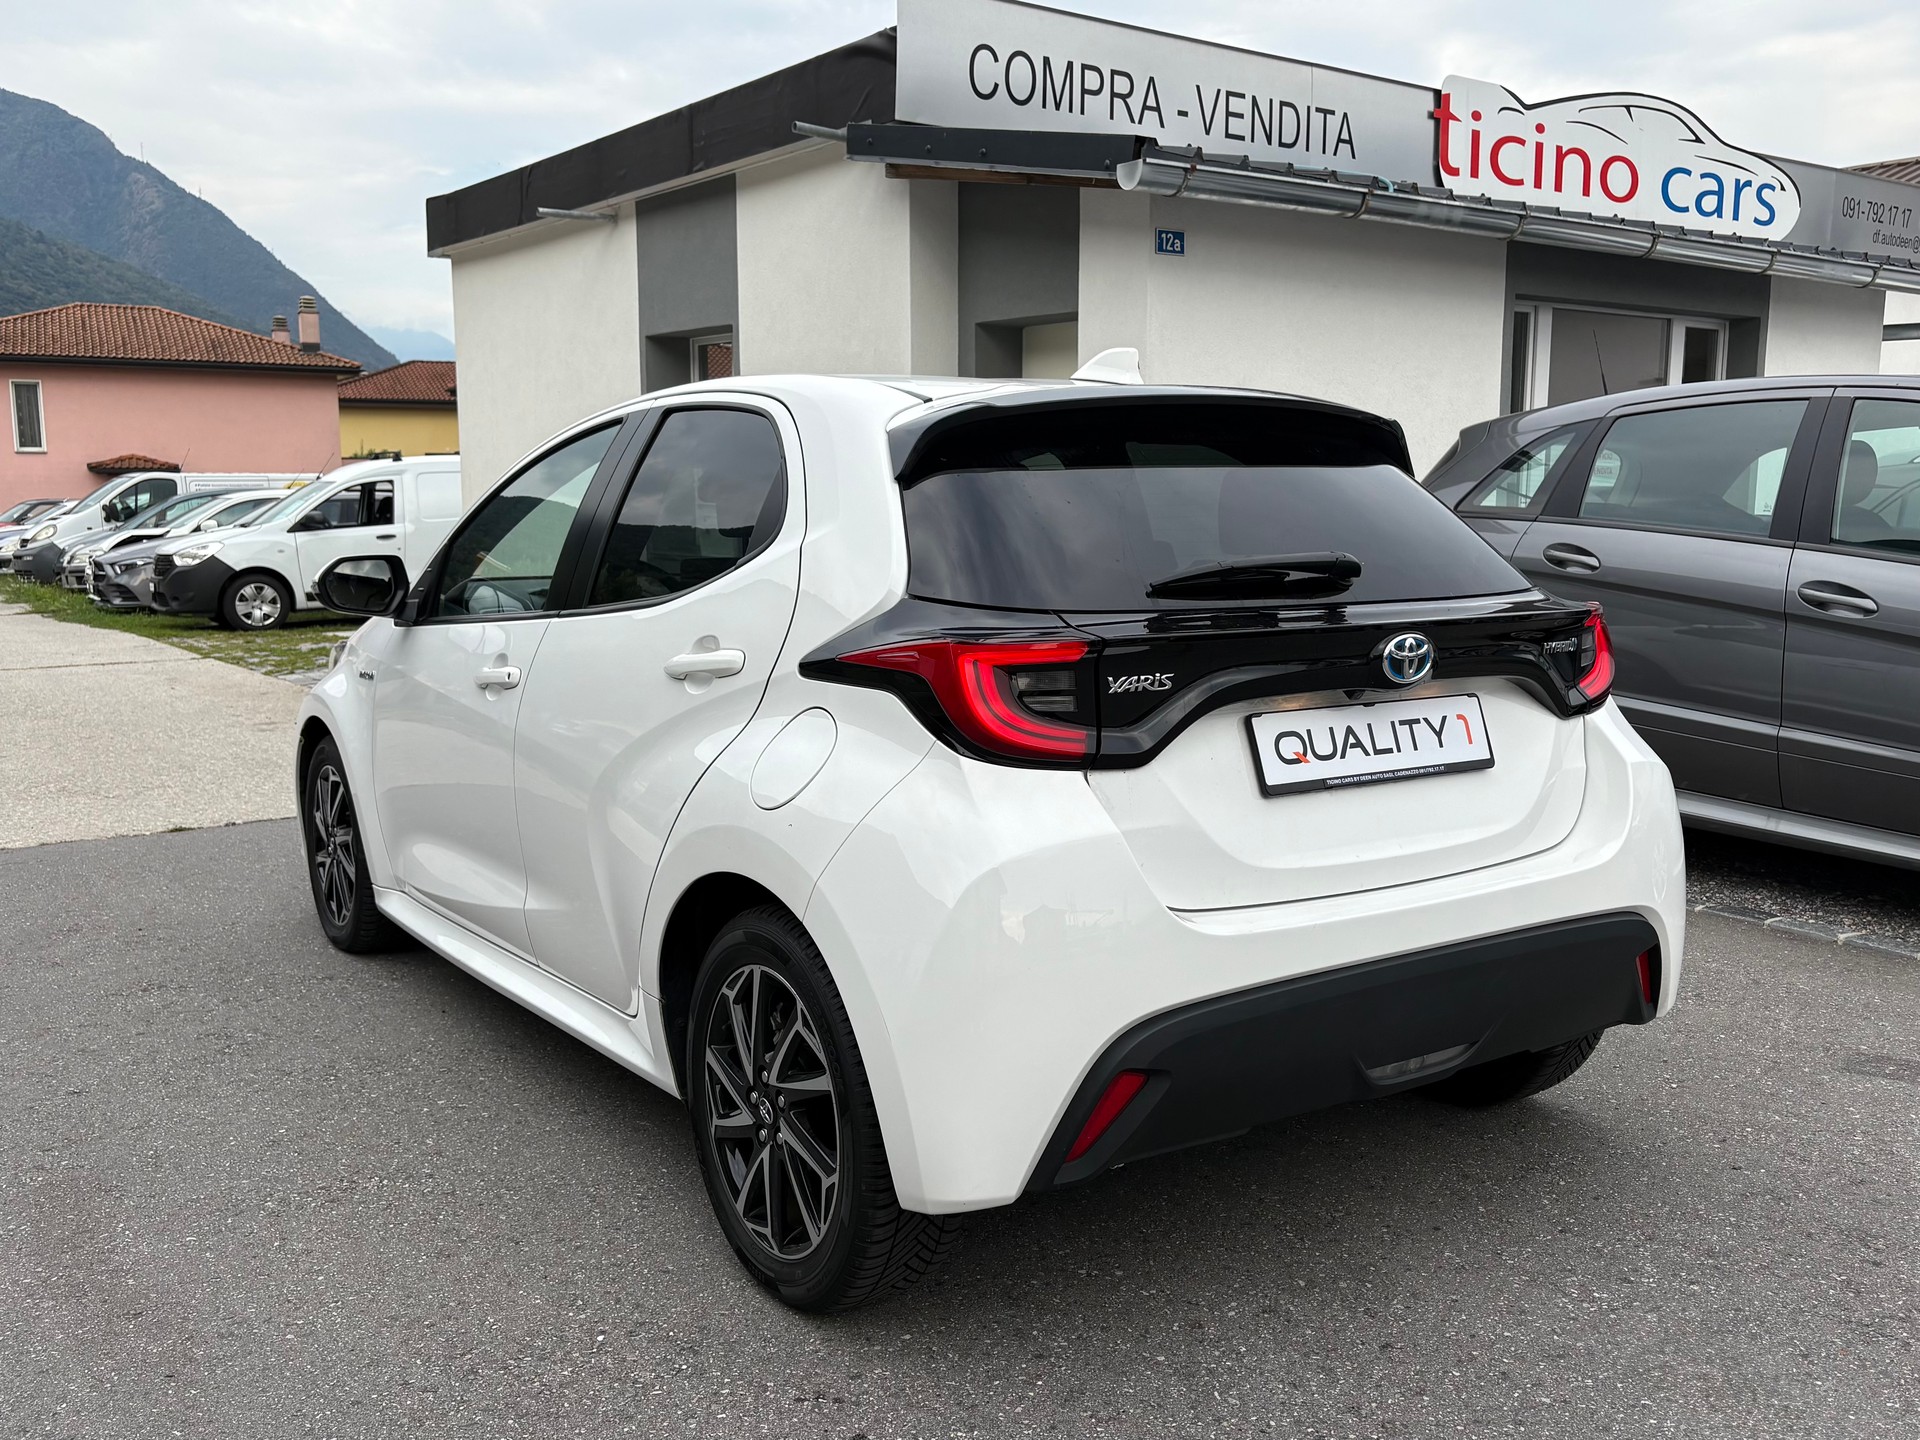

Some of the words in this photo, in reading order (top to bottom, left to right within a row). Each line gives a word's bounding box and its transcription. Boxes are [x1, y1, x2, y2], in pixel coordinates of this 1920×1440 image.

[969, 43, 1165, 129] COMPRA
[1195, 84, 1356, 160] VENDITA
[1433, 92, 1639, 203] ticino
[1661, 167, 1777, 226] cars
[1842, 196, 1885, 224] 091-792
[1888, 205, 1899, 226] 17
[1902, 207, 1912, 228] 17
[1161, 233, 1181, 251] 12a
[1274, 715, 1448, 765] QUALITY
[1456, 713, 1473, 745] 1
